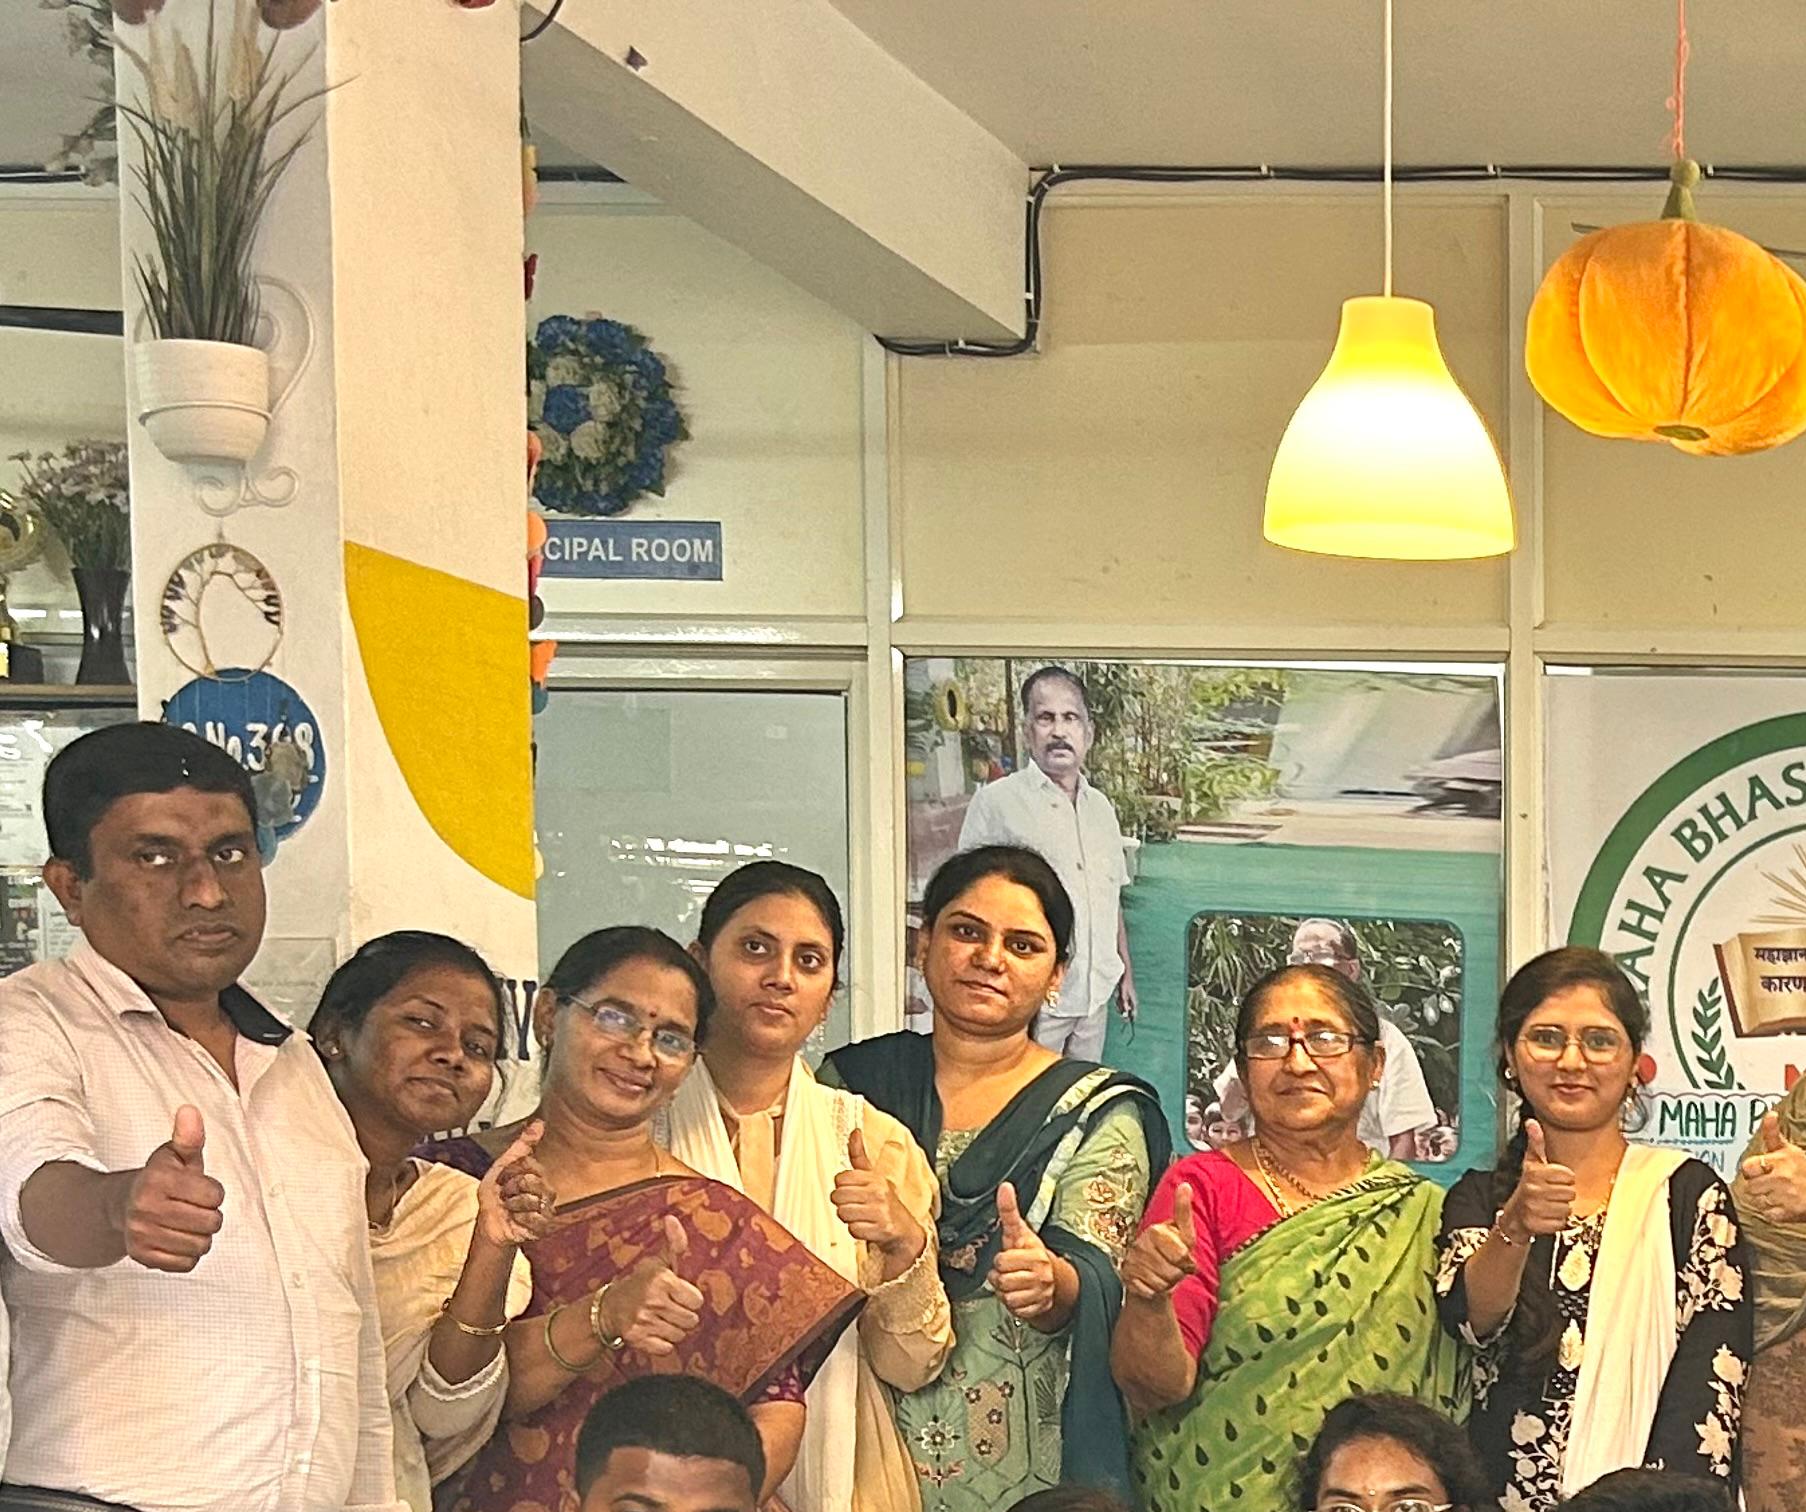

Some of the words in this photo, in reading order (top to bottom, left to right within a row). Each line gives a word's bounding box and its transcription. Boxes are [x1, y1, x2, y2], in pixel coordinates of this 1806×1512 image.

[544, 537, 624, 562] CIPAL
[631, 538, 713, 563] ROOM
[1614, 865, 1689, 1000] AHA
[1659, 1099, 1737, 1138] MAHA
